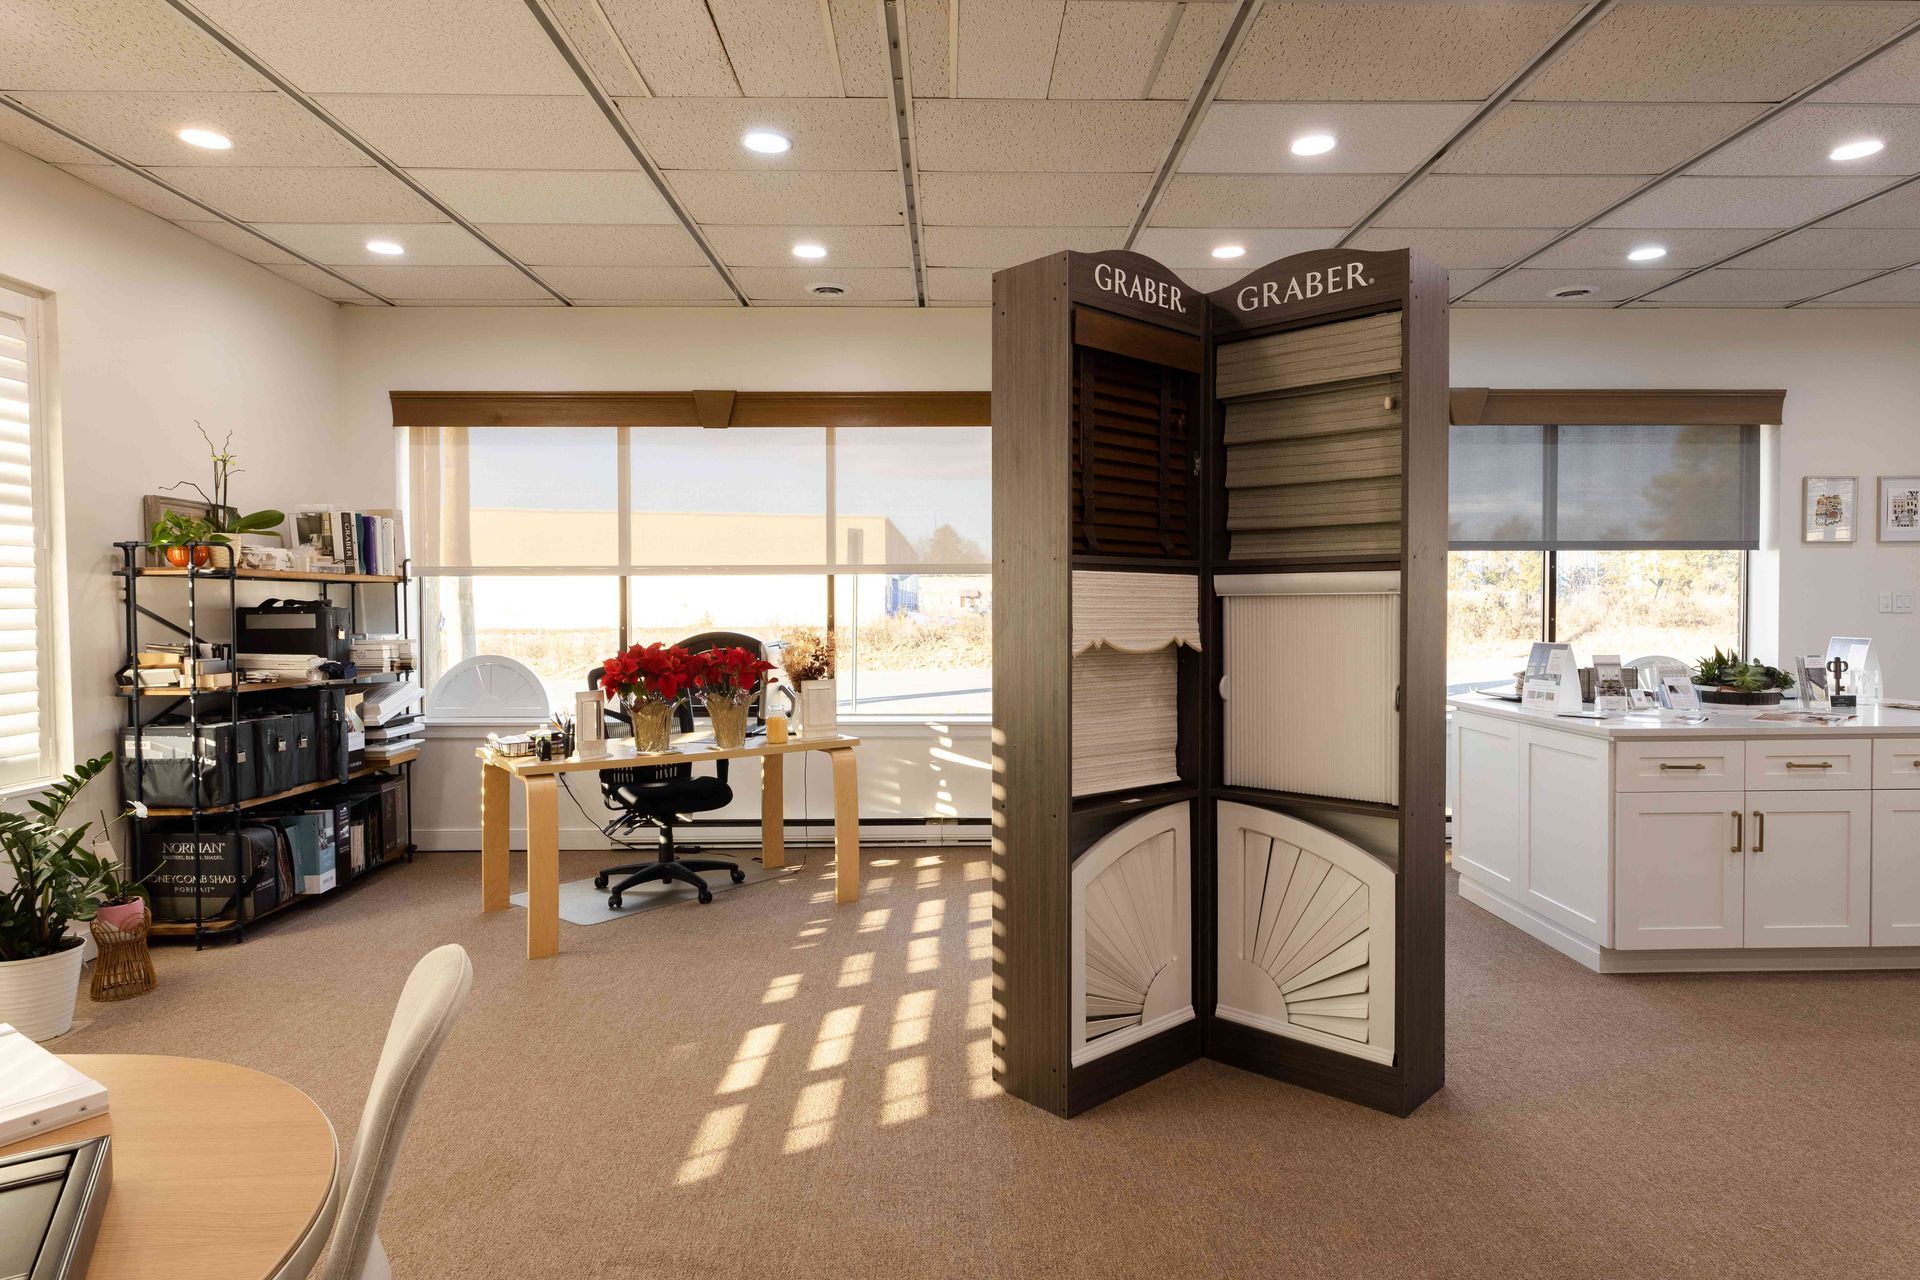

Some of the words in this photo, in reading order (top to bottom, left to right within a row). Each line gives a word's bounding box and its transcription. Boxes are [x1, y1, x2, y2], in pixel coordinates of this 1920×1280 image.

[1094, 263, 1184, 313] GRABER
[344, 522, 353, 557] GRABER
[162, 842, 222, 854] NORMAN
[147, 874, 207, 884] ONEYCOMB
[209, 874, 247, 884] SHADS
